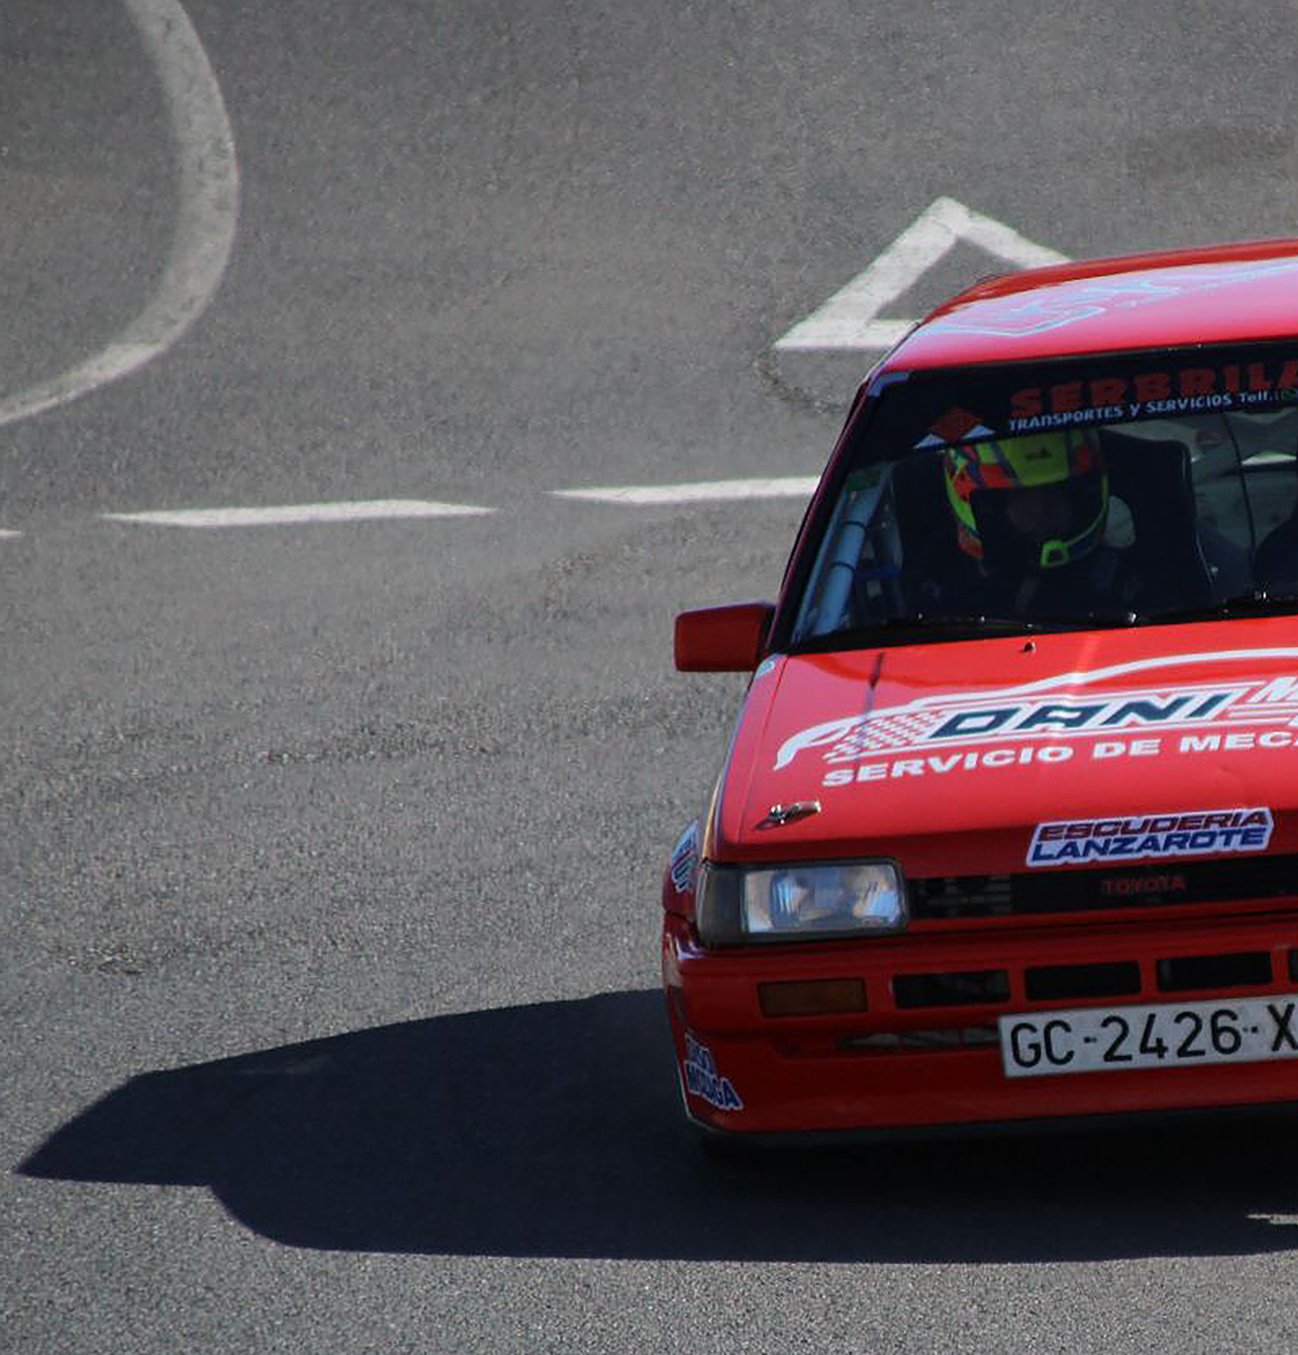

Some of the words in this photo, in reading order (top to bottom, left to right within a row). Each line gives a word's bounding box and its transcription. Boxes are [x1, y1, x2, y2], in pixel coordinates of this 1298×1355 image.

[1009, 405, 1124, 431] TRANSPORTES
[1145, 392, 1233, 414] SERVICIOS
[926, 692, 1235, 740] DANI
[821, 745, 1074, 788] SERVICIO
[1092, 738, 1162, 759] DE
[1031, 826, 1269, 862] LANZAROTE
[1038, 810, 1269, 842] ESCUDERIA
[1103, 874, 1187, 895] TOYOTA
